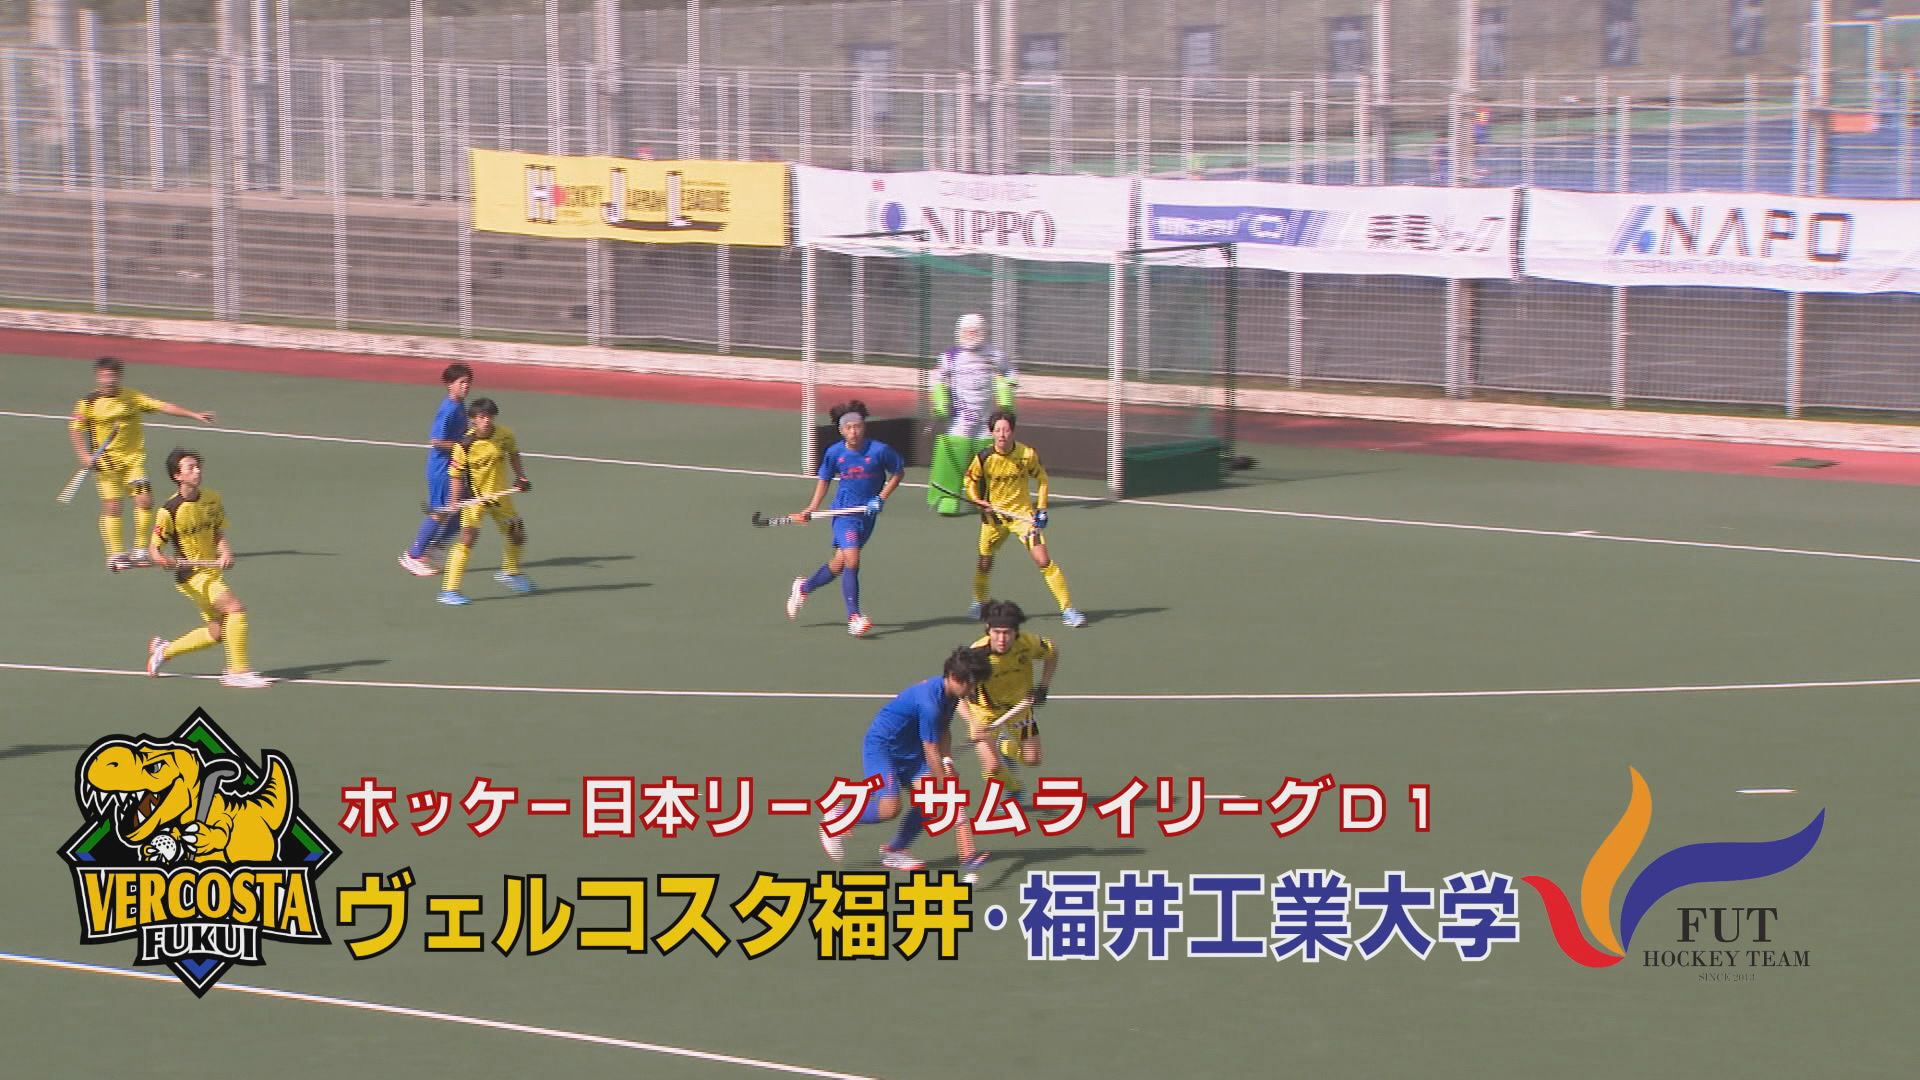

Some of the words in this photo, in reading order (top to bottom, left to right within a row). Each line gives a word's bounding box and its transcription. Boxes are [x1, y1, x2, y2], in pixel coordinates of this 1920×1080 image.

[921, 206, 1057, 249] NIPPO
[1366, 214, 1506, 252] 東尾メック
